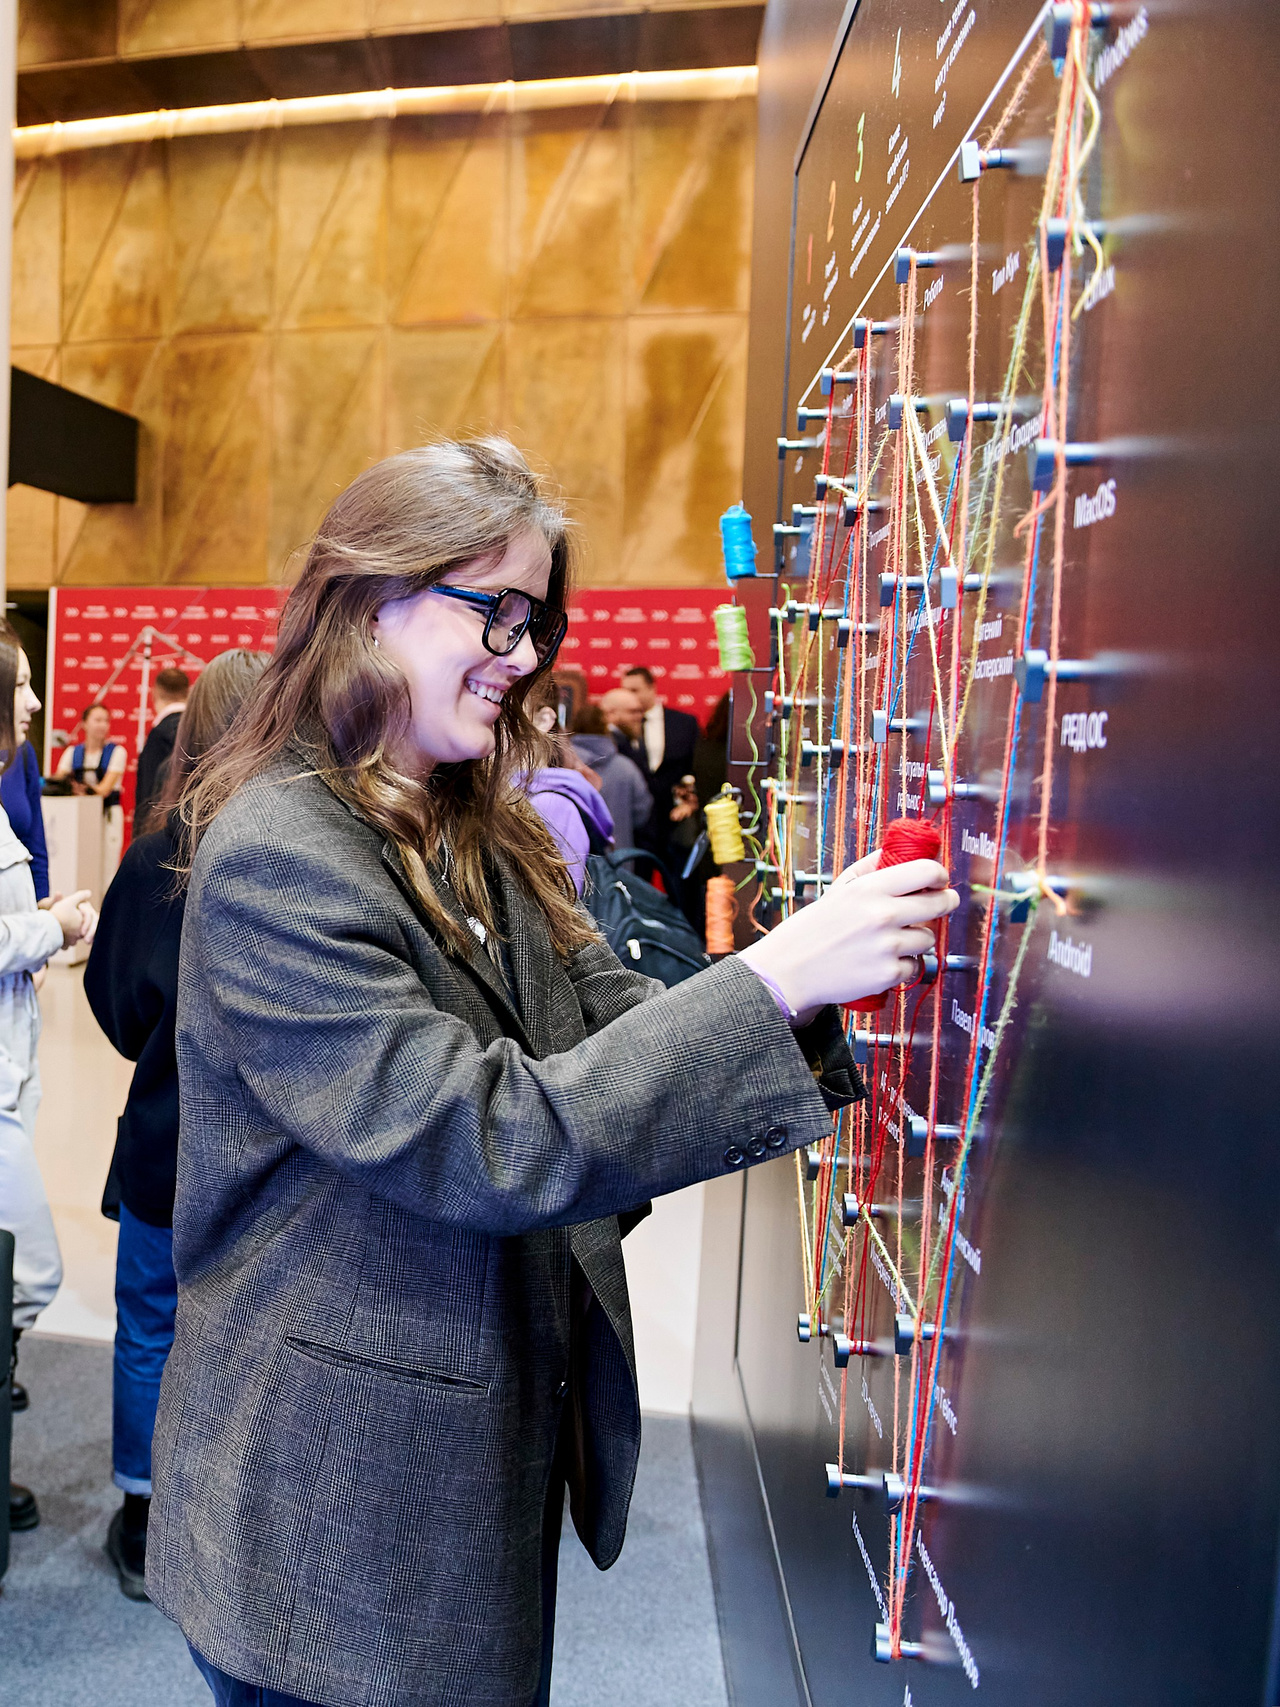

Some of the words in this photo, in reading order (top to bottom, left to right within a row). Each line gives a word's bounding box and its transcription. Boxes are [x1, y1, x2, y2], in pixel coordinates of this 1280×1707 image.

[1094, 6, 1149, 91] Windows
[923, 274, 944, 311] Роботы
[1074, 477, 1117, 529] MacOS
[1047, 930, 1093, 978] Android
[916, 1529, 948, 1617] Александр
